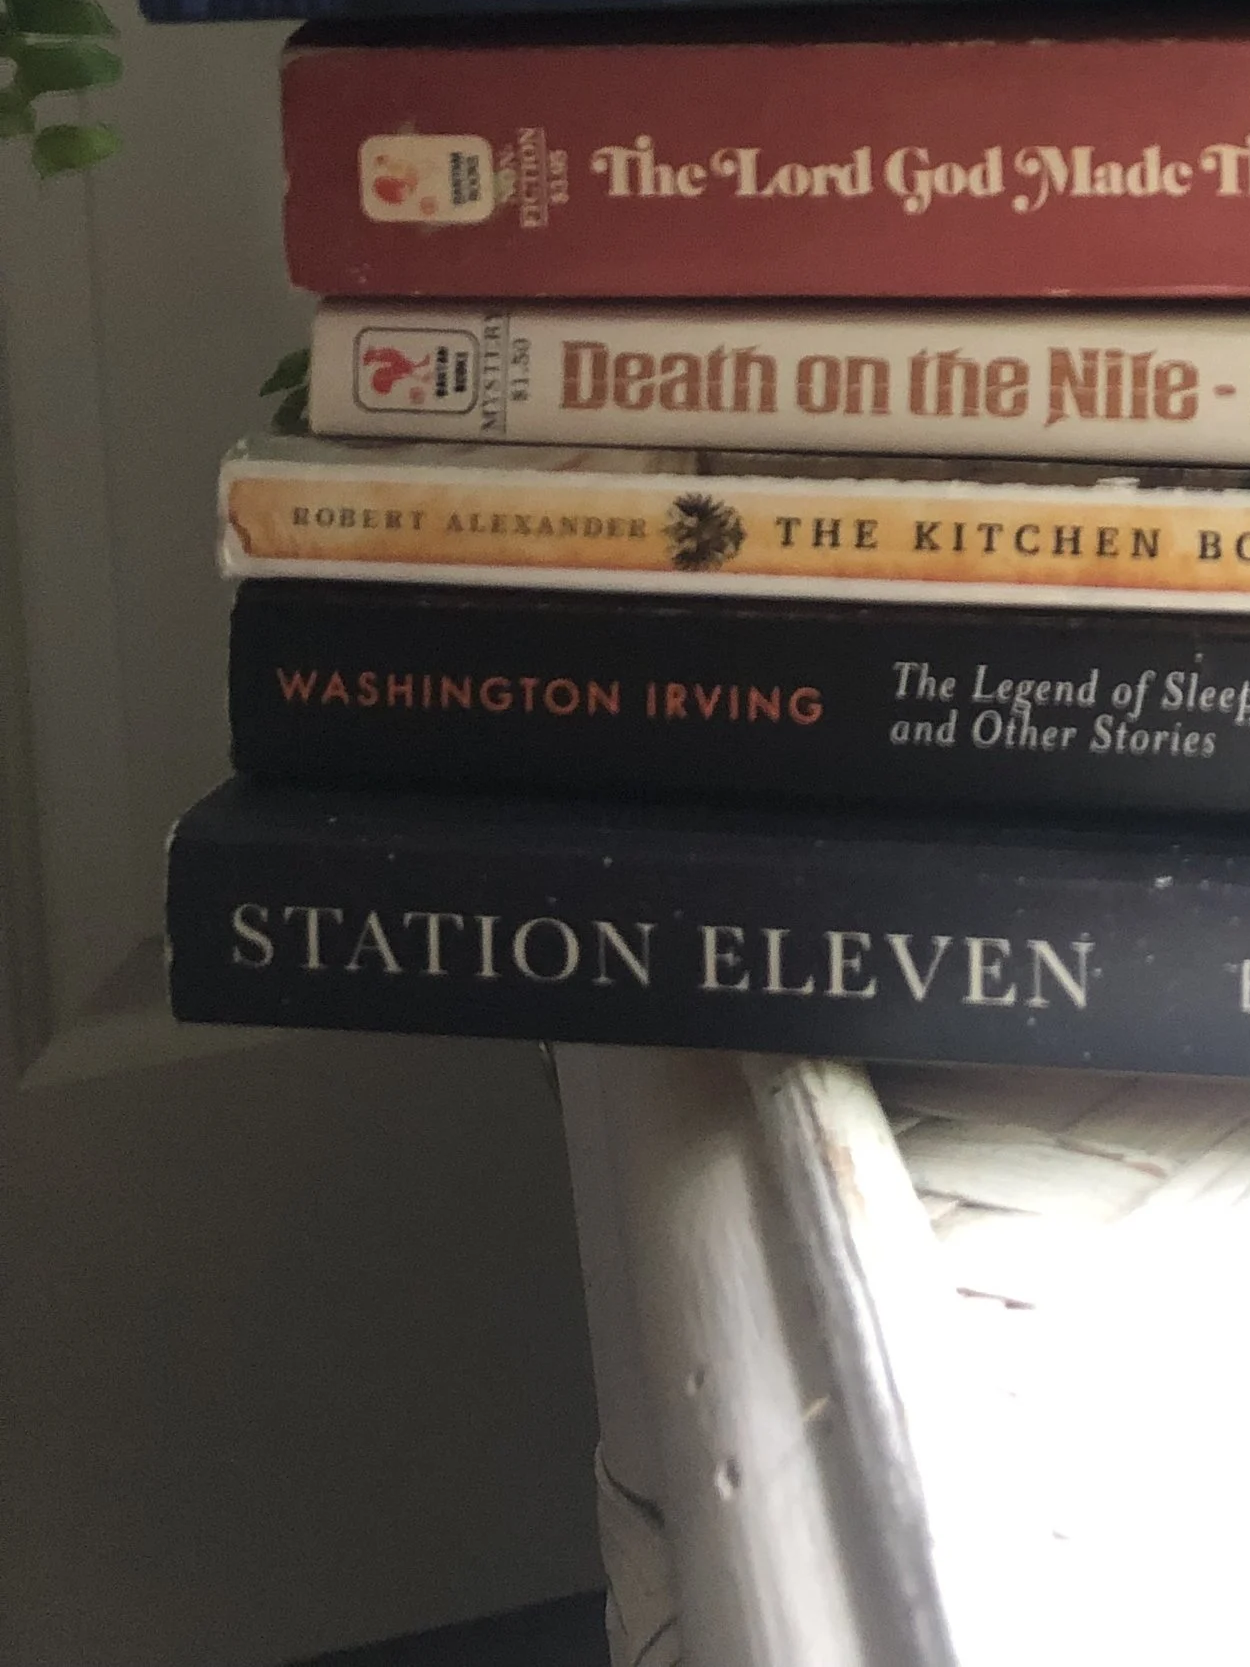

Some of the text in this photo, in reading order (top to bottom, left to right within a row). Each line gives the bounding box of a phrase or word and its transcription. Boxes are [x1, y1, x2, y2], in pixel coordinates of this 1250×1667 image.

[591, 134, 708, 199] The
[710, 144, 874, 198] Lord
[884, 145, 1005, 215] God
[1011, 144, 1194, 215] Made
[560, 340, 779, 414] Death
[796, 352, 892, 417] on
[907, 347, 1030, 419] the
[1043, 346, 1200, 427] Nile
[292, 505, 647, 543] ROBERT ALEXANDER
[775, 516, 879, 550] THE
[913, 520, 1161, 559] KITCHEN
[276, 668, 824, 726] WASHINGTON IRVING
[893, 661, 956, 702] The
[972, 664, 1098, 715] Legend
[1110, 670, 1157, 721] of
[890, 705, 1217, 759] and Other Stories
[231, 902, 1096, 1011] STATION ELEVEN
